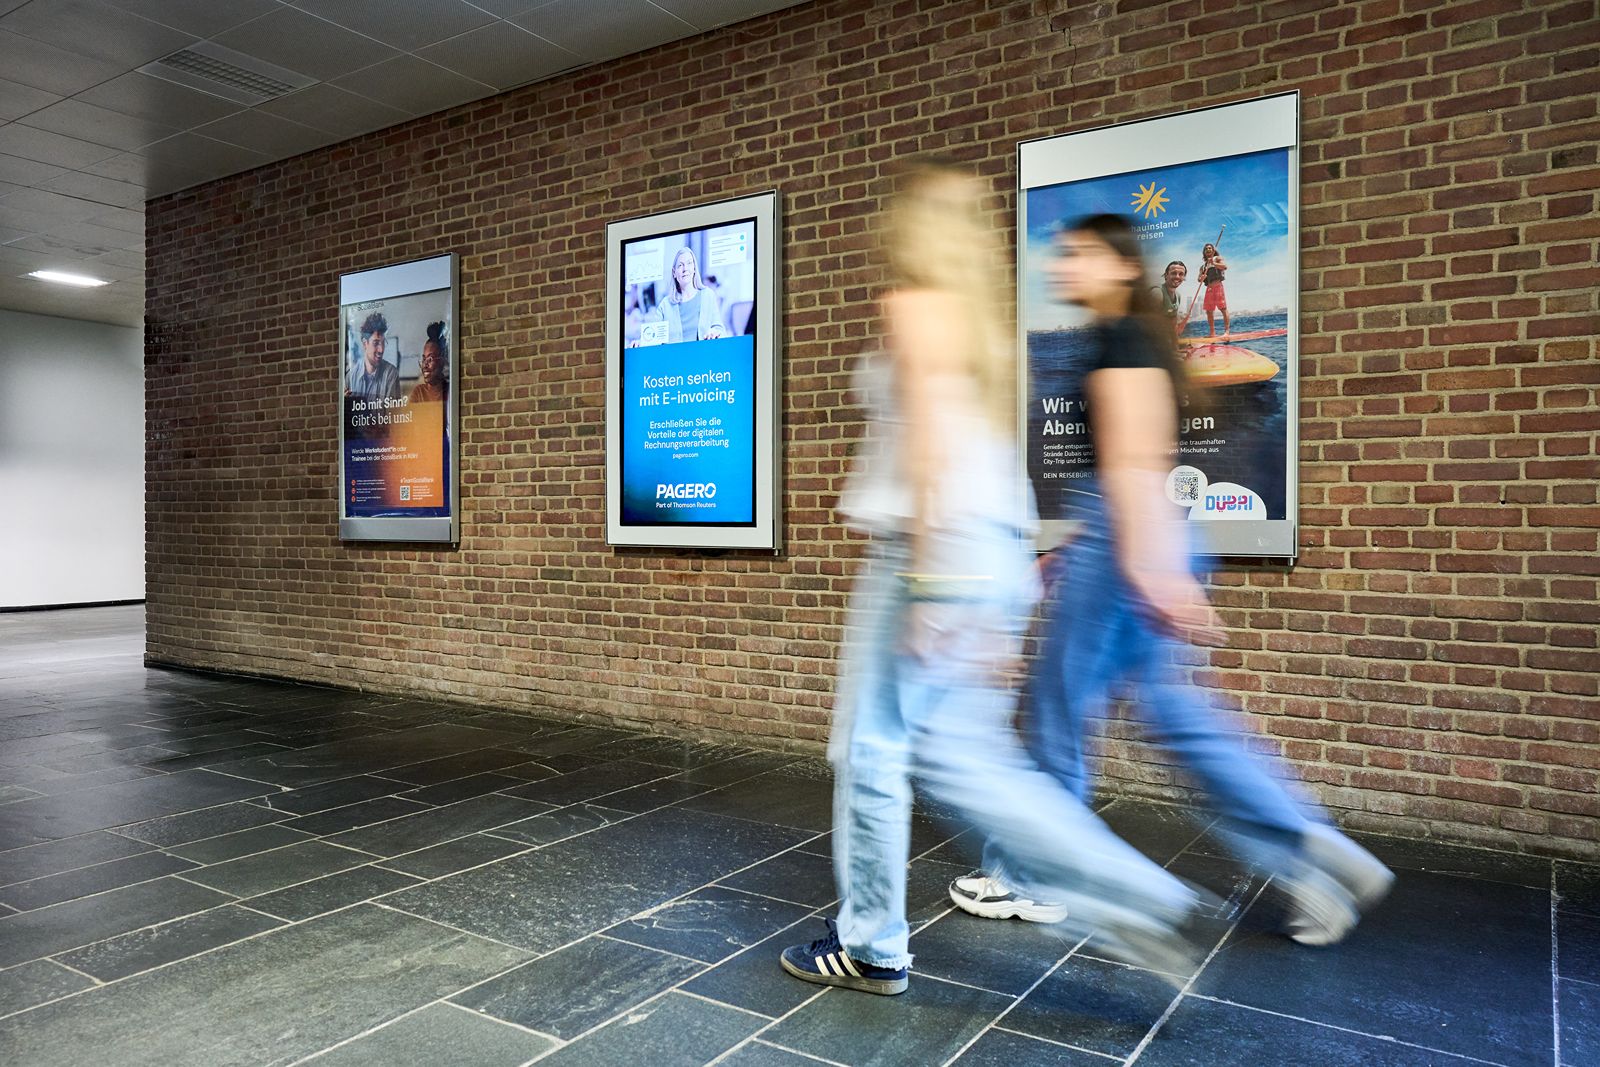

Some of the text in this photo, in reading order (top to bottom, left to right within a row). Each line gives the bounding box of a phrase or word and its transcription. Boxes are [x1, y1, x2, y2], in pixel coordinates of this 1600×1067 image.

[1137, 231, 1164, 240] reisen
[643, 370, 731, 389] Kosten senken
[352, 395, 408, 411] Job mit Sinn?
[639, 387, 735, 407] mit E-invoicing
[1042, 397, 1074, 414] Wir
[378, 412, 391, 425] bei
[393, 411, 412, 424] uns!
[649, 417, 721, 429] Erschließen Sie die
[647, 428, 724, 439] Vorteile der digitalen
[644, 438, 729, 450] Rechnungsverarbeitung
[1189, 438, 1226, 446] traumhaften
[656, 482, 716, 499] PAGERO
[1205, 495, 1252, 511] DUBAI
